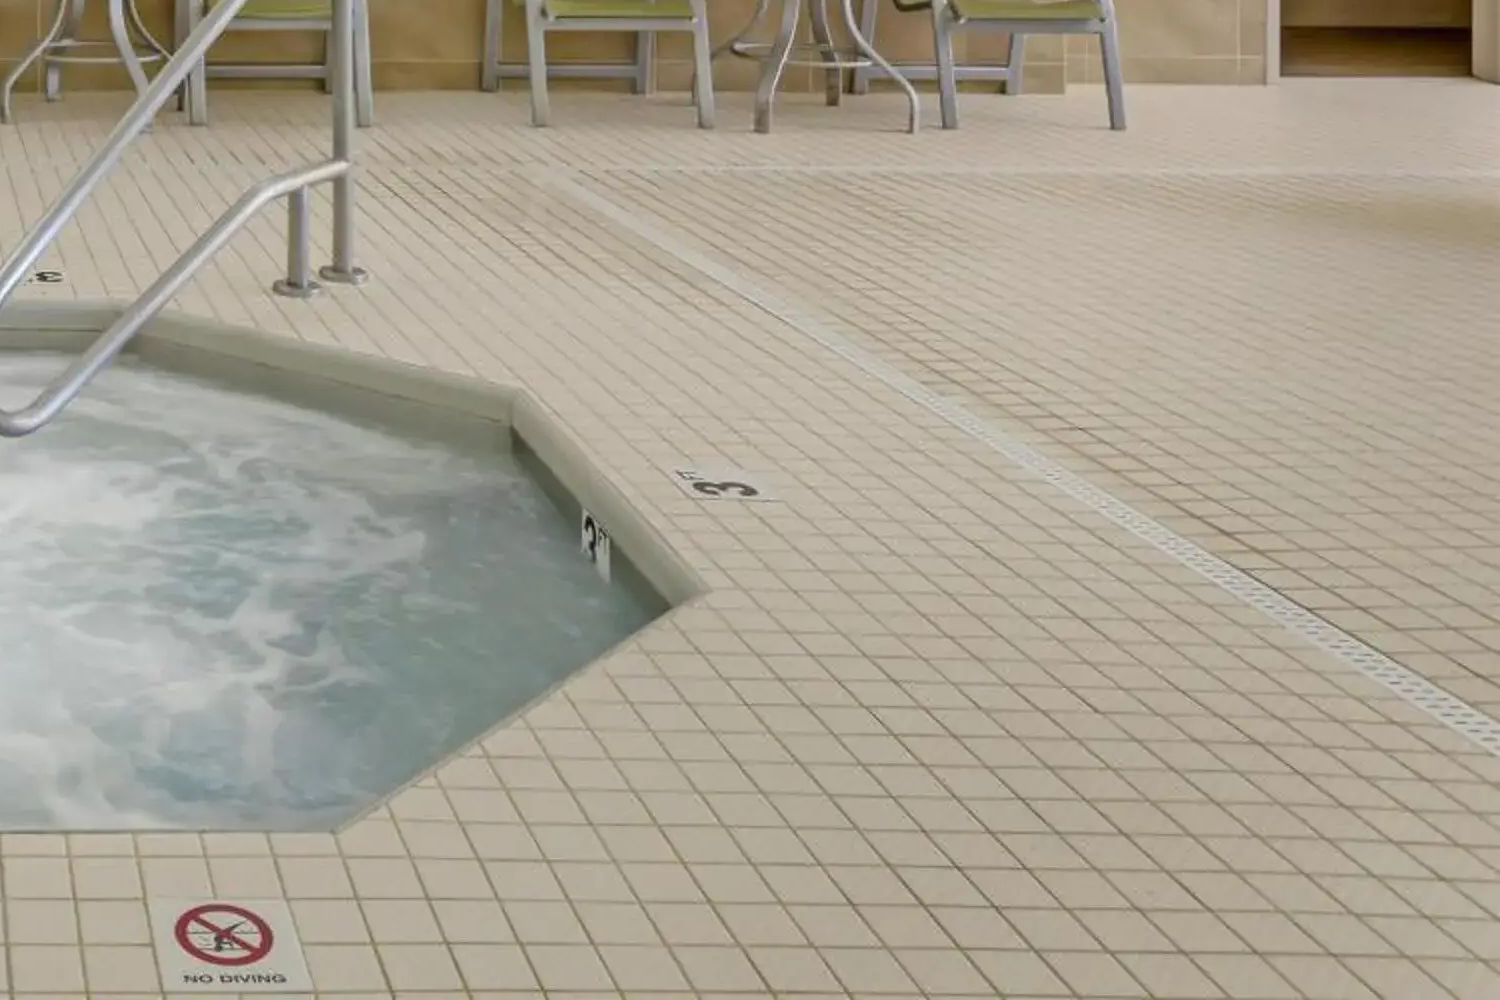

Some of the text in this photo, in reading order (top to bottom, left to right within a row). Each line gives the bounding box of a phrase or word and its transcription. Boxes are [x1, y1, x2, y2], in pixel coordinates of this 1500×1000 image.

[692, 481, 759, 497] 3
[182, 973, 288, 985] NO DIVING
